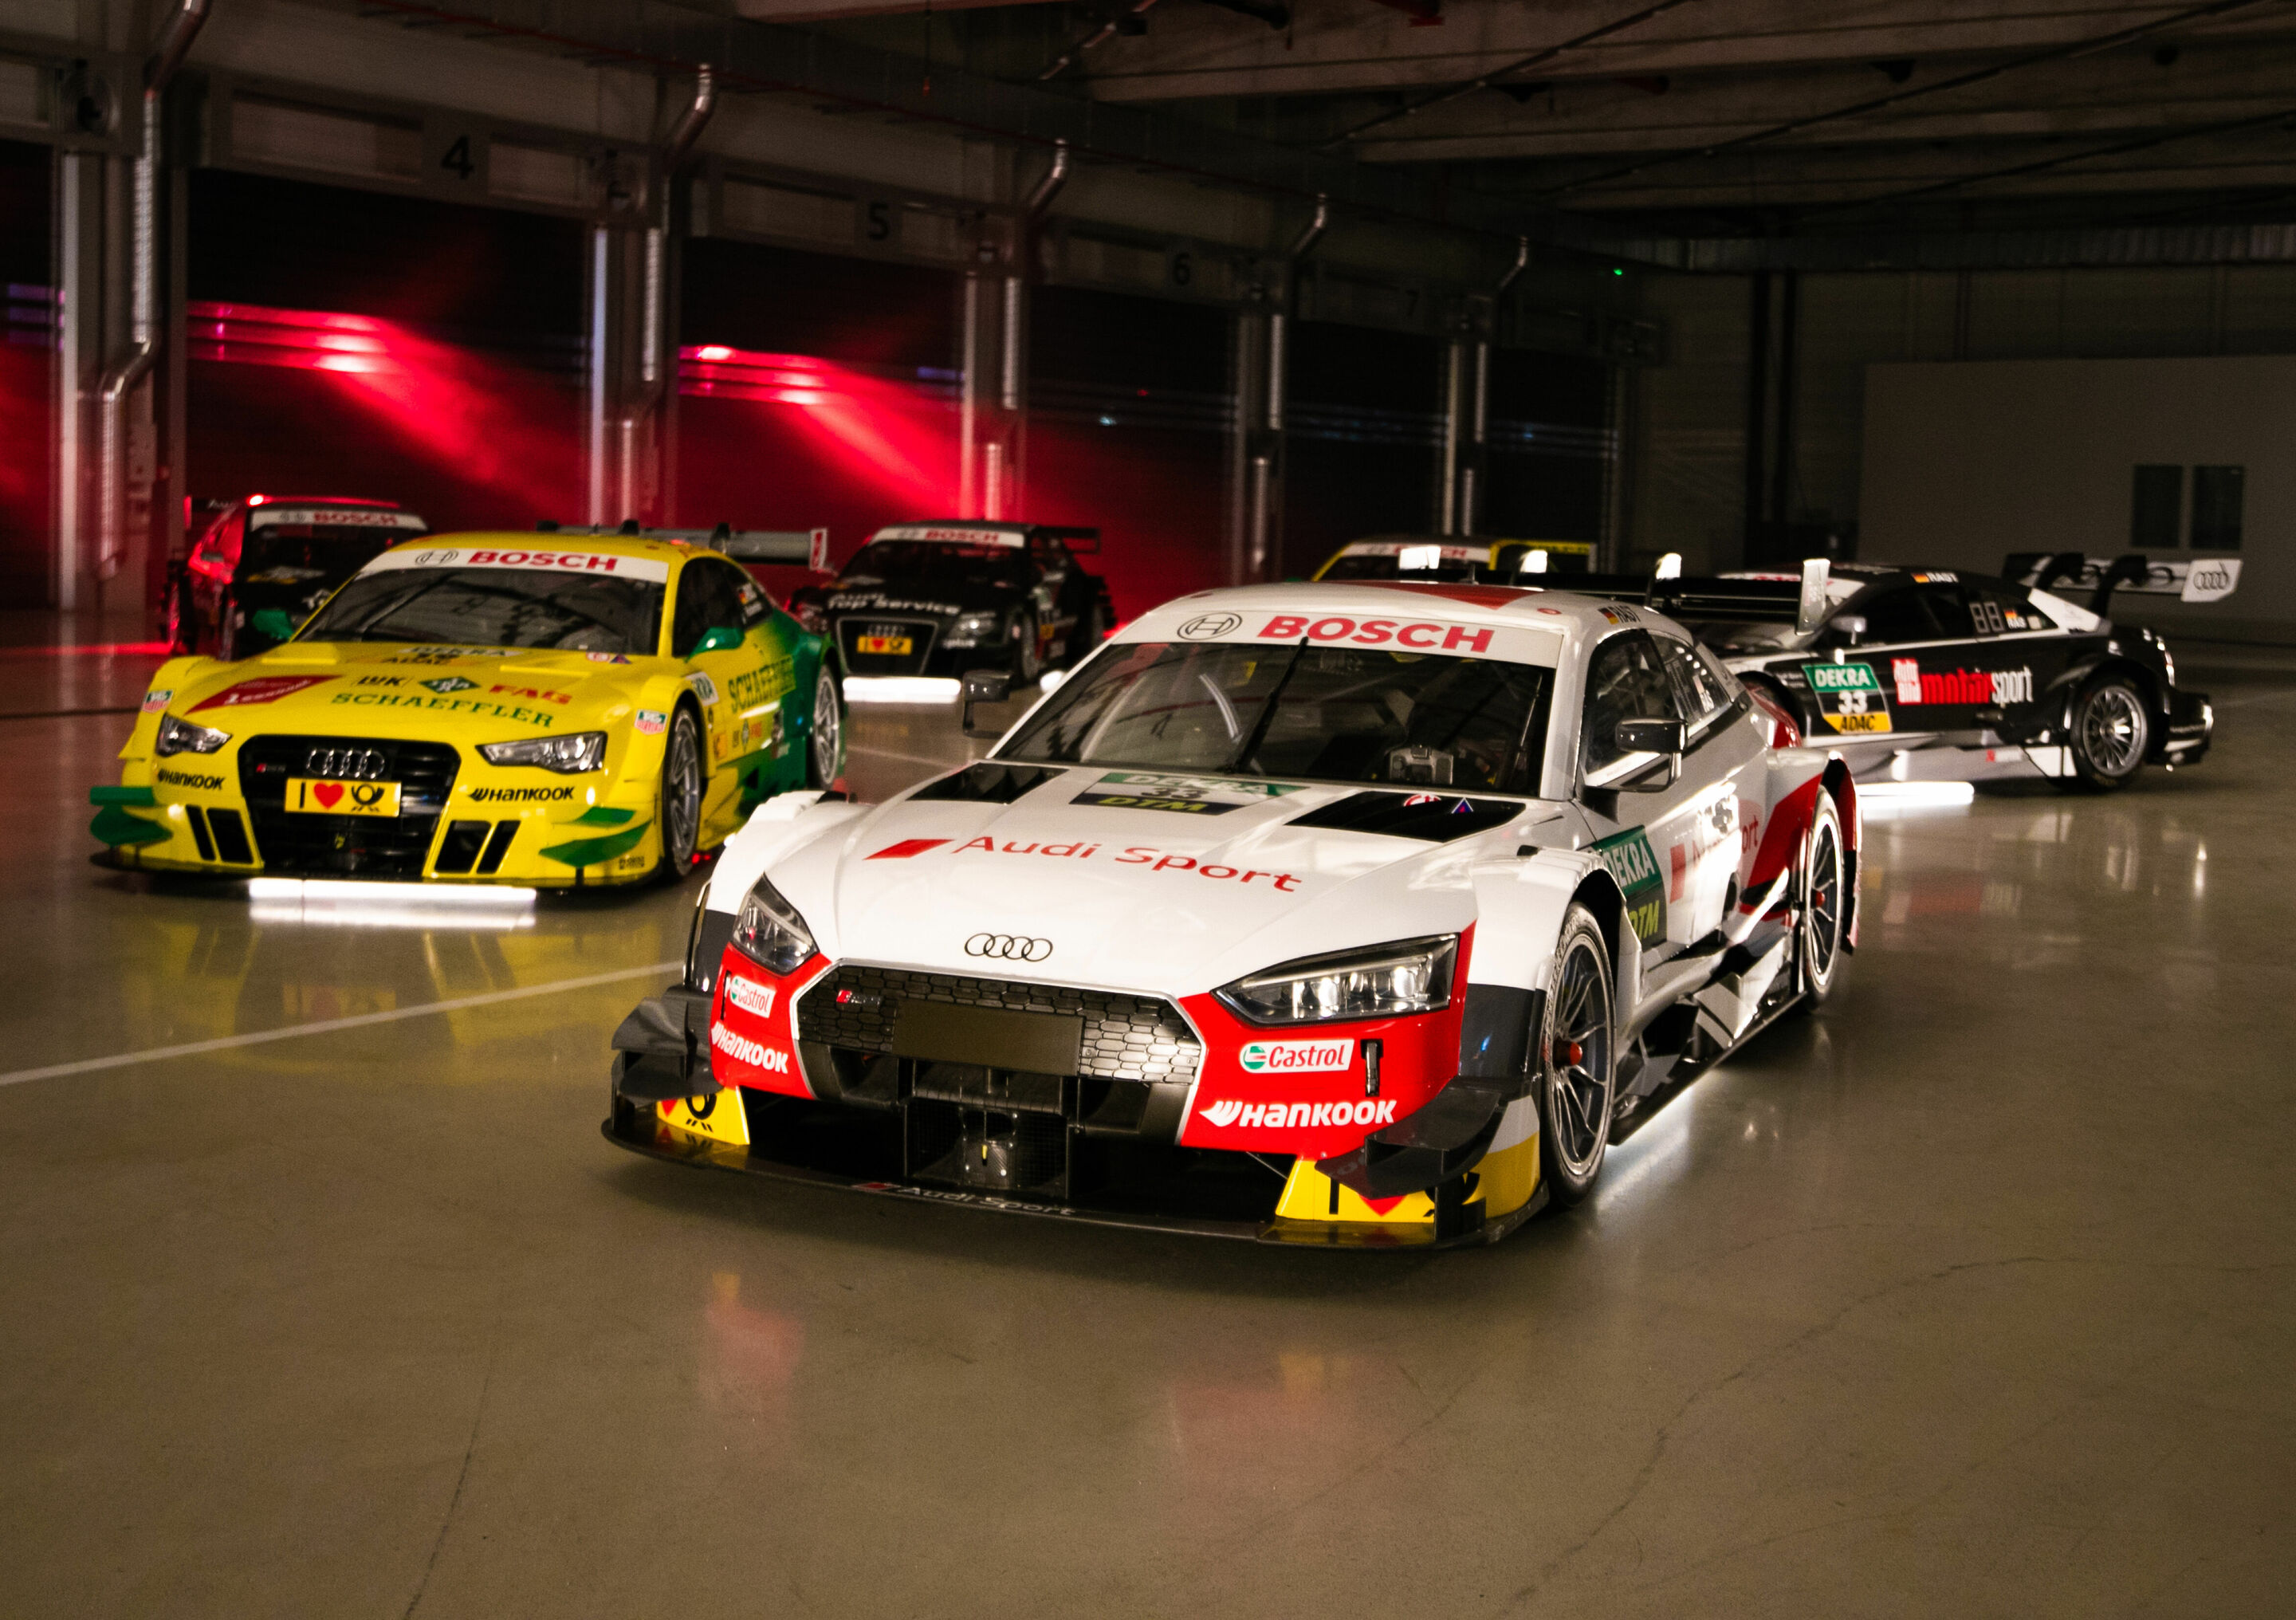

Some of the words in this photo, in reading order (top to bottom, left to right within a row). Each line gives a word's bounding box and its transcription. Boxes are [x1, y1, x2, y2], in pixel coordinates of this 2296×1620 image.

[441, 135, 475, 180] 4
[869, 202, 889, 240] 5
[1173, 252, 1190, 285] 6
[313, 510, 398, 525] BOSCH
[925, 529, 1000, 543] BOSCH
[468, 551, 619, 572] BOSCH
[1927, 572, 1959, 584] RAST
[1256, 615, 1495, 654] BOSCH
[1814, 667, 1871, 688] DEKRA
[489, 684, 573, 705] FAG
[1838, 690, 1868, 714] 33
[332, 693, 554, 728] SCHAEFFLER
[1841, 714, 1875, 731] ADAC
[1098, 796, 1209, 812] DTM
[1142, 787, 1210, 800] 33
[951, 836, 1102, 859] Audi
[1115, 847, 1303, 892] Sport
[1602, 837, 1656, 888] DEKRA
[737, 982, 771, 1013] Castrol
[1268, 1044, 1346, 1069] Castrol
[897, 1186, 976, 1202] Audi
[979, 1197, 1076, 1216] Sport
